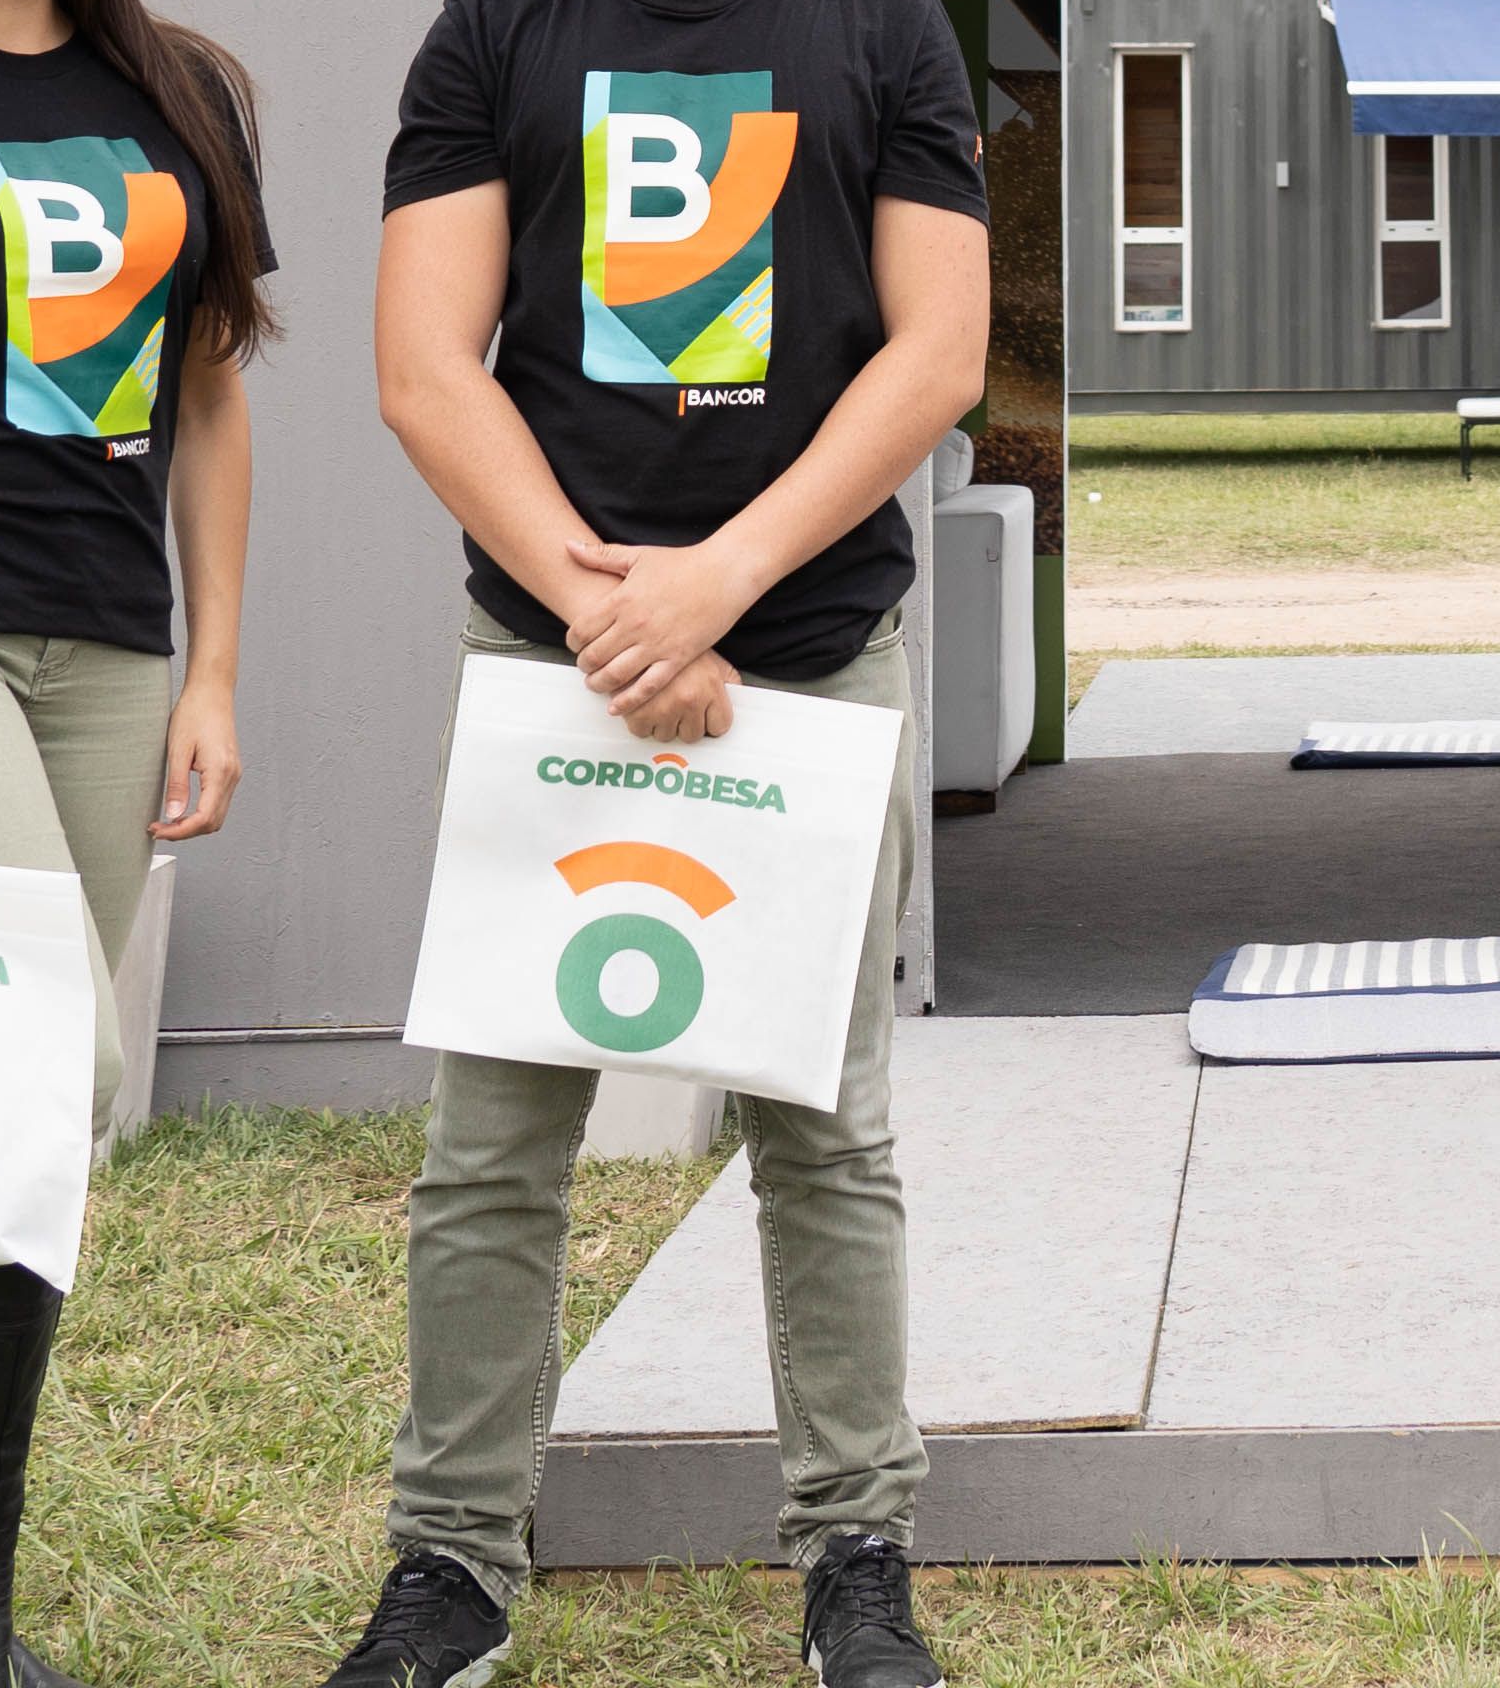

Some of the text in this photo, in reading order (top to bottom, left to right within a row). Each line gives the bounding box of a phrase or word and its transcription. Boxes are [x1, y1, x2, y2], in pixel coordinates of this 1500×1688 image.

[7, 177, 124, 298] B
[606, 113, 711, 243] B
[687, 388, 765, 407] BANCOR
